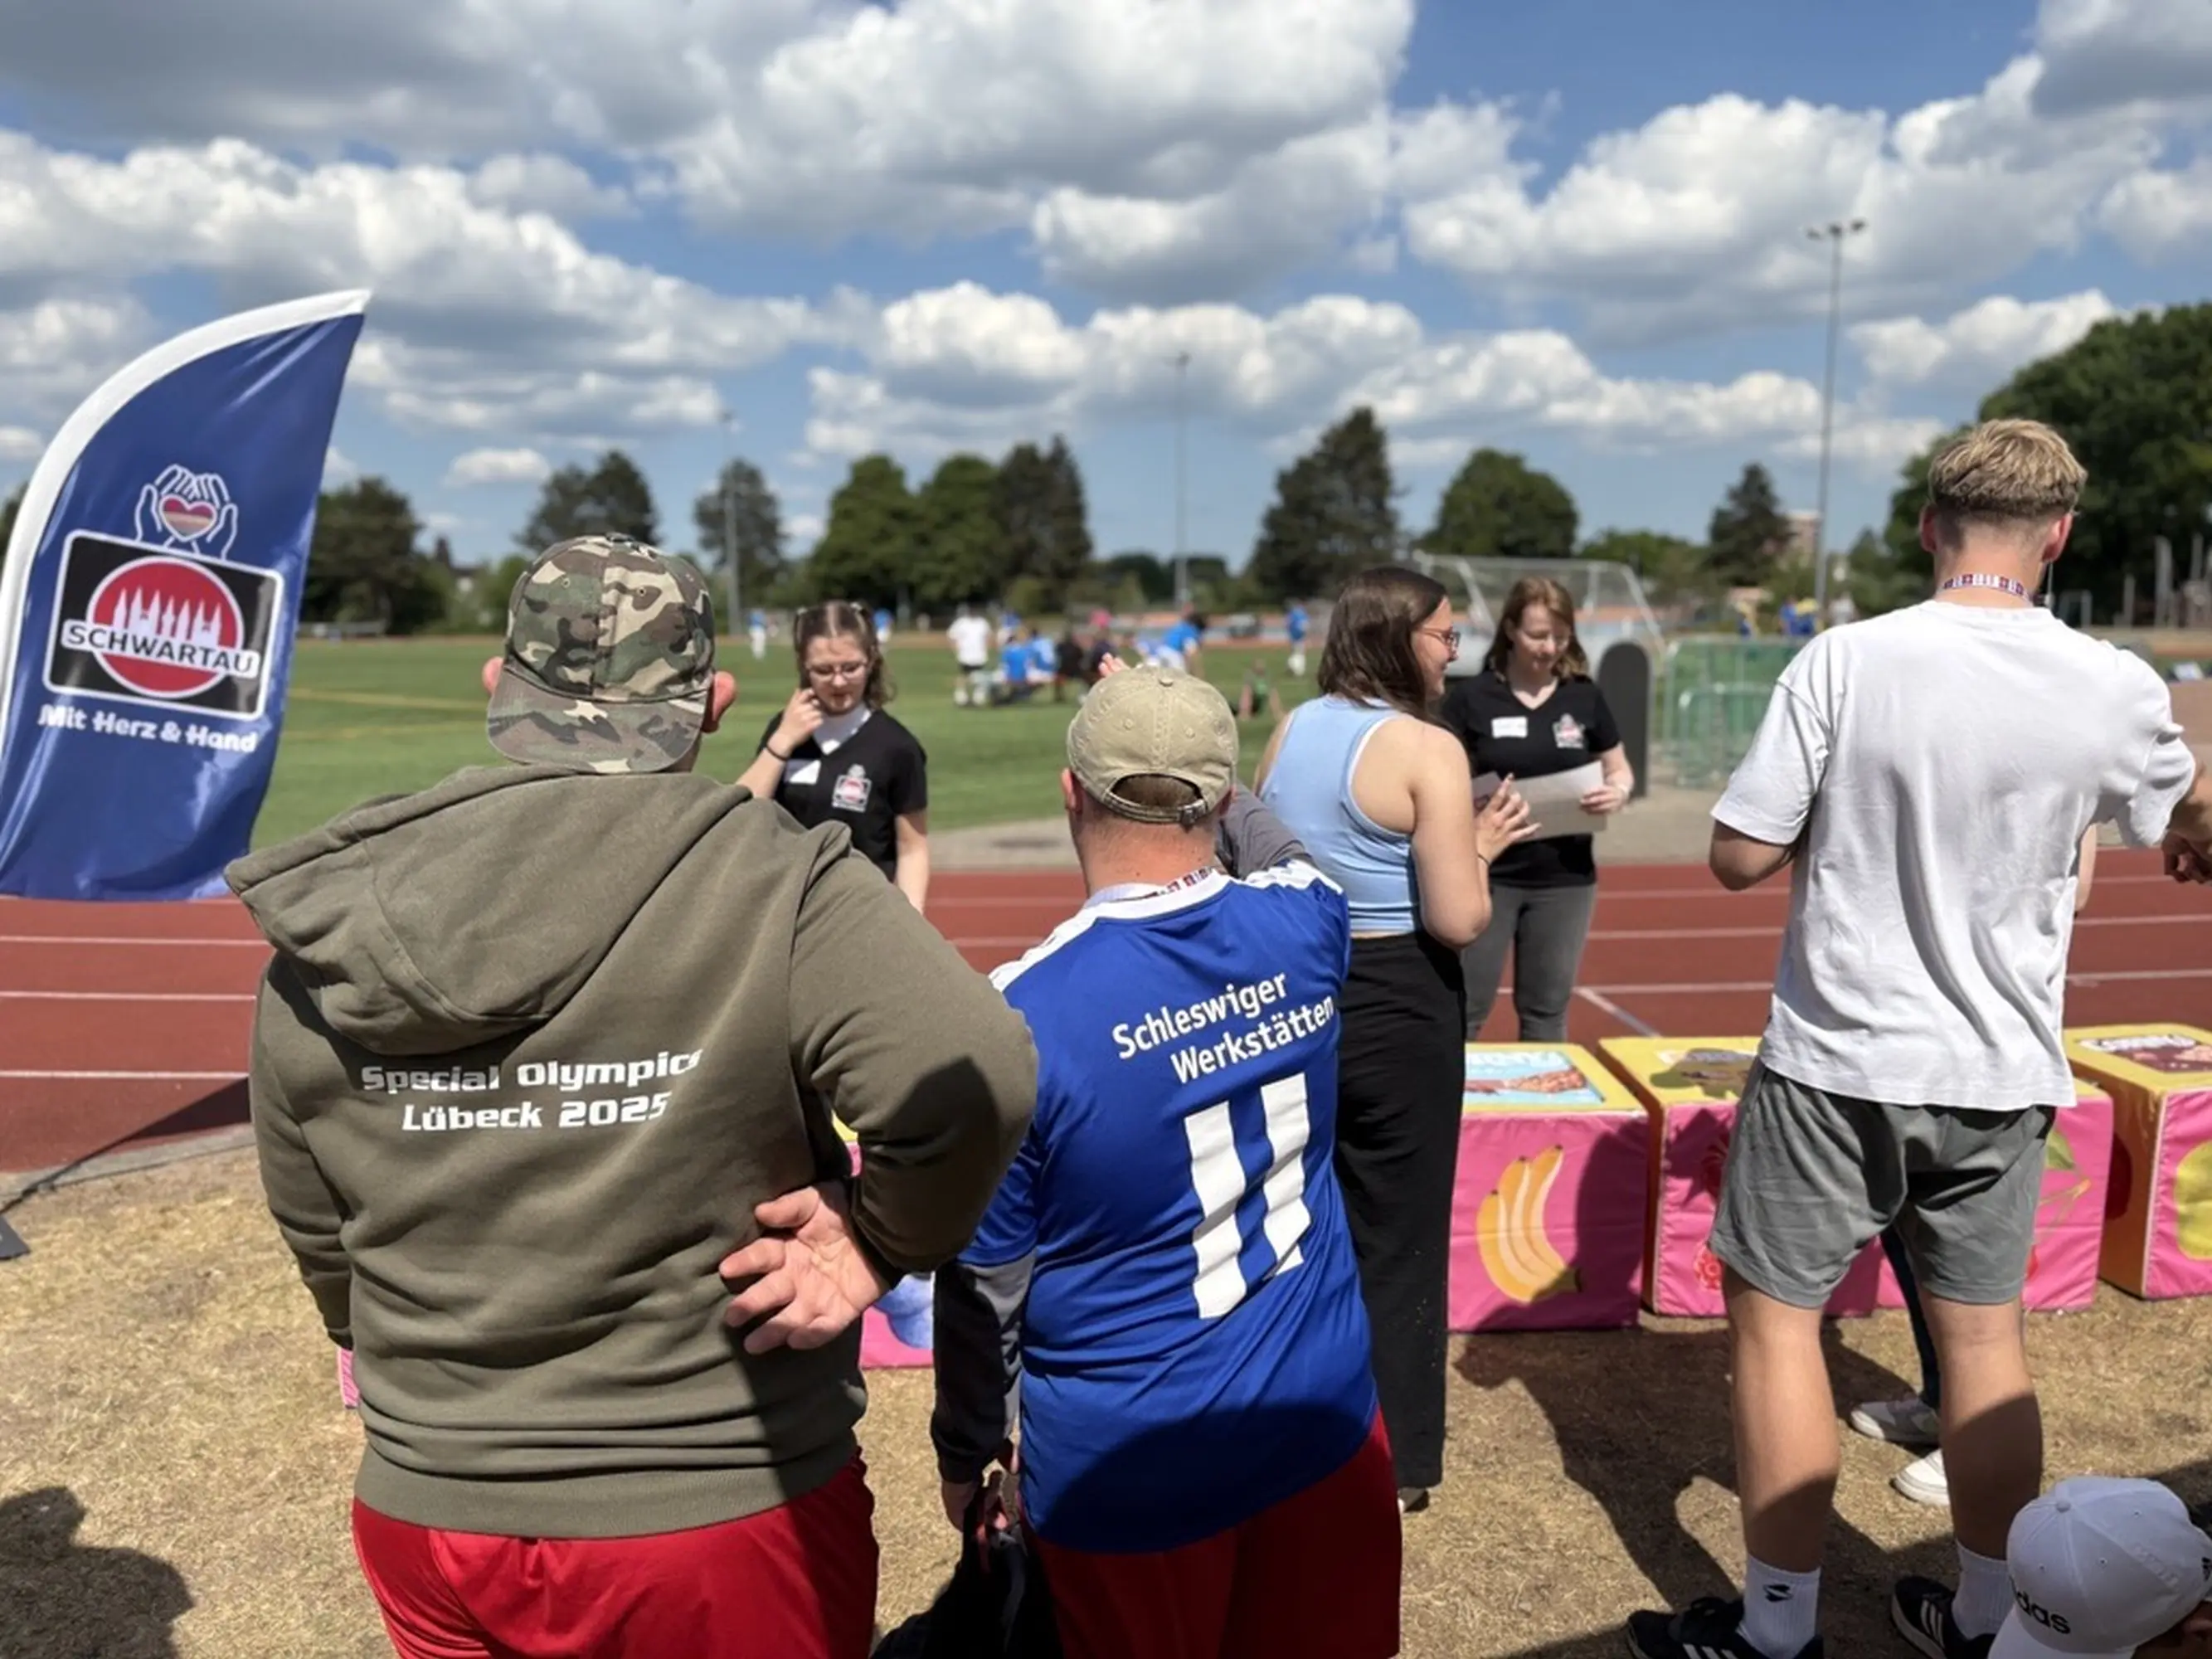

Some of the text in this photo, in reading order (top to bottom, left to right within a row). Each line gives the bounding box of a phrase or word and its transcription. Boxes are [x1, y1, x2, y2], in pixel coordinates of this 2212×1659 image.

[67, 624, 254, 674] SCHWARTAU
[38, 703, 258, 752] Mit Herz & Hand
[1112, 972, 1286, 1059] Schleswiger
[1170, 995, 1334, 1083] Werkstätten
[362, 1065, 501, 1094] Special
[402, 1092, 673, 1131] Lübeck 2025
[1184, 1073, 1311, 1320] 11
[2015, 1590, 2071, 1634] das
